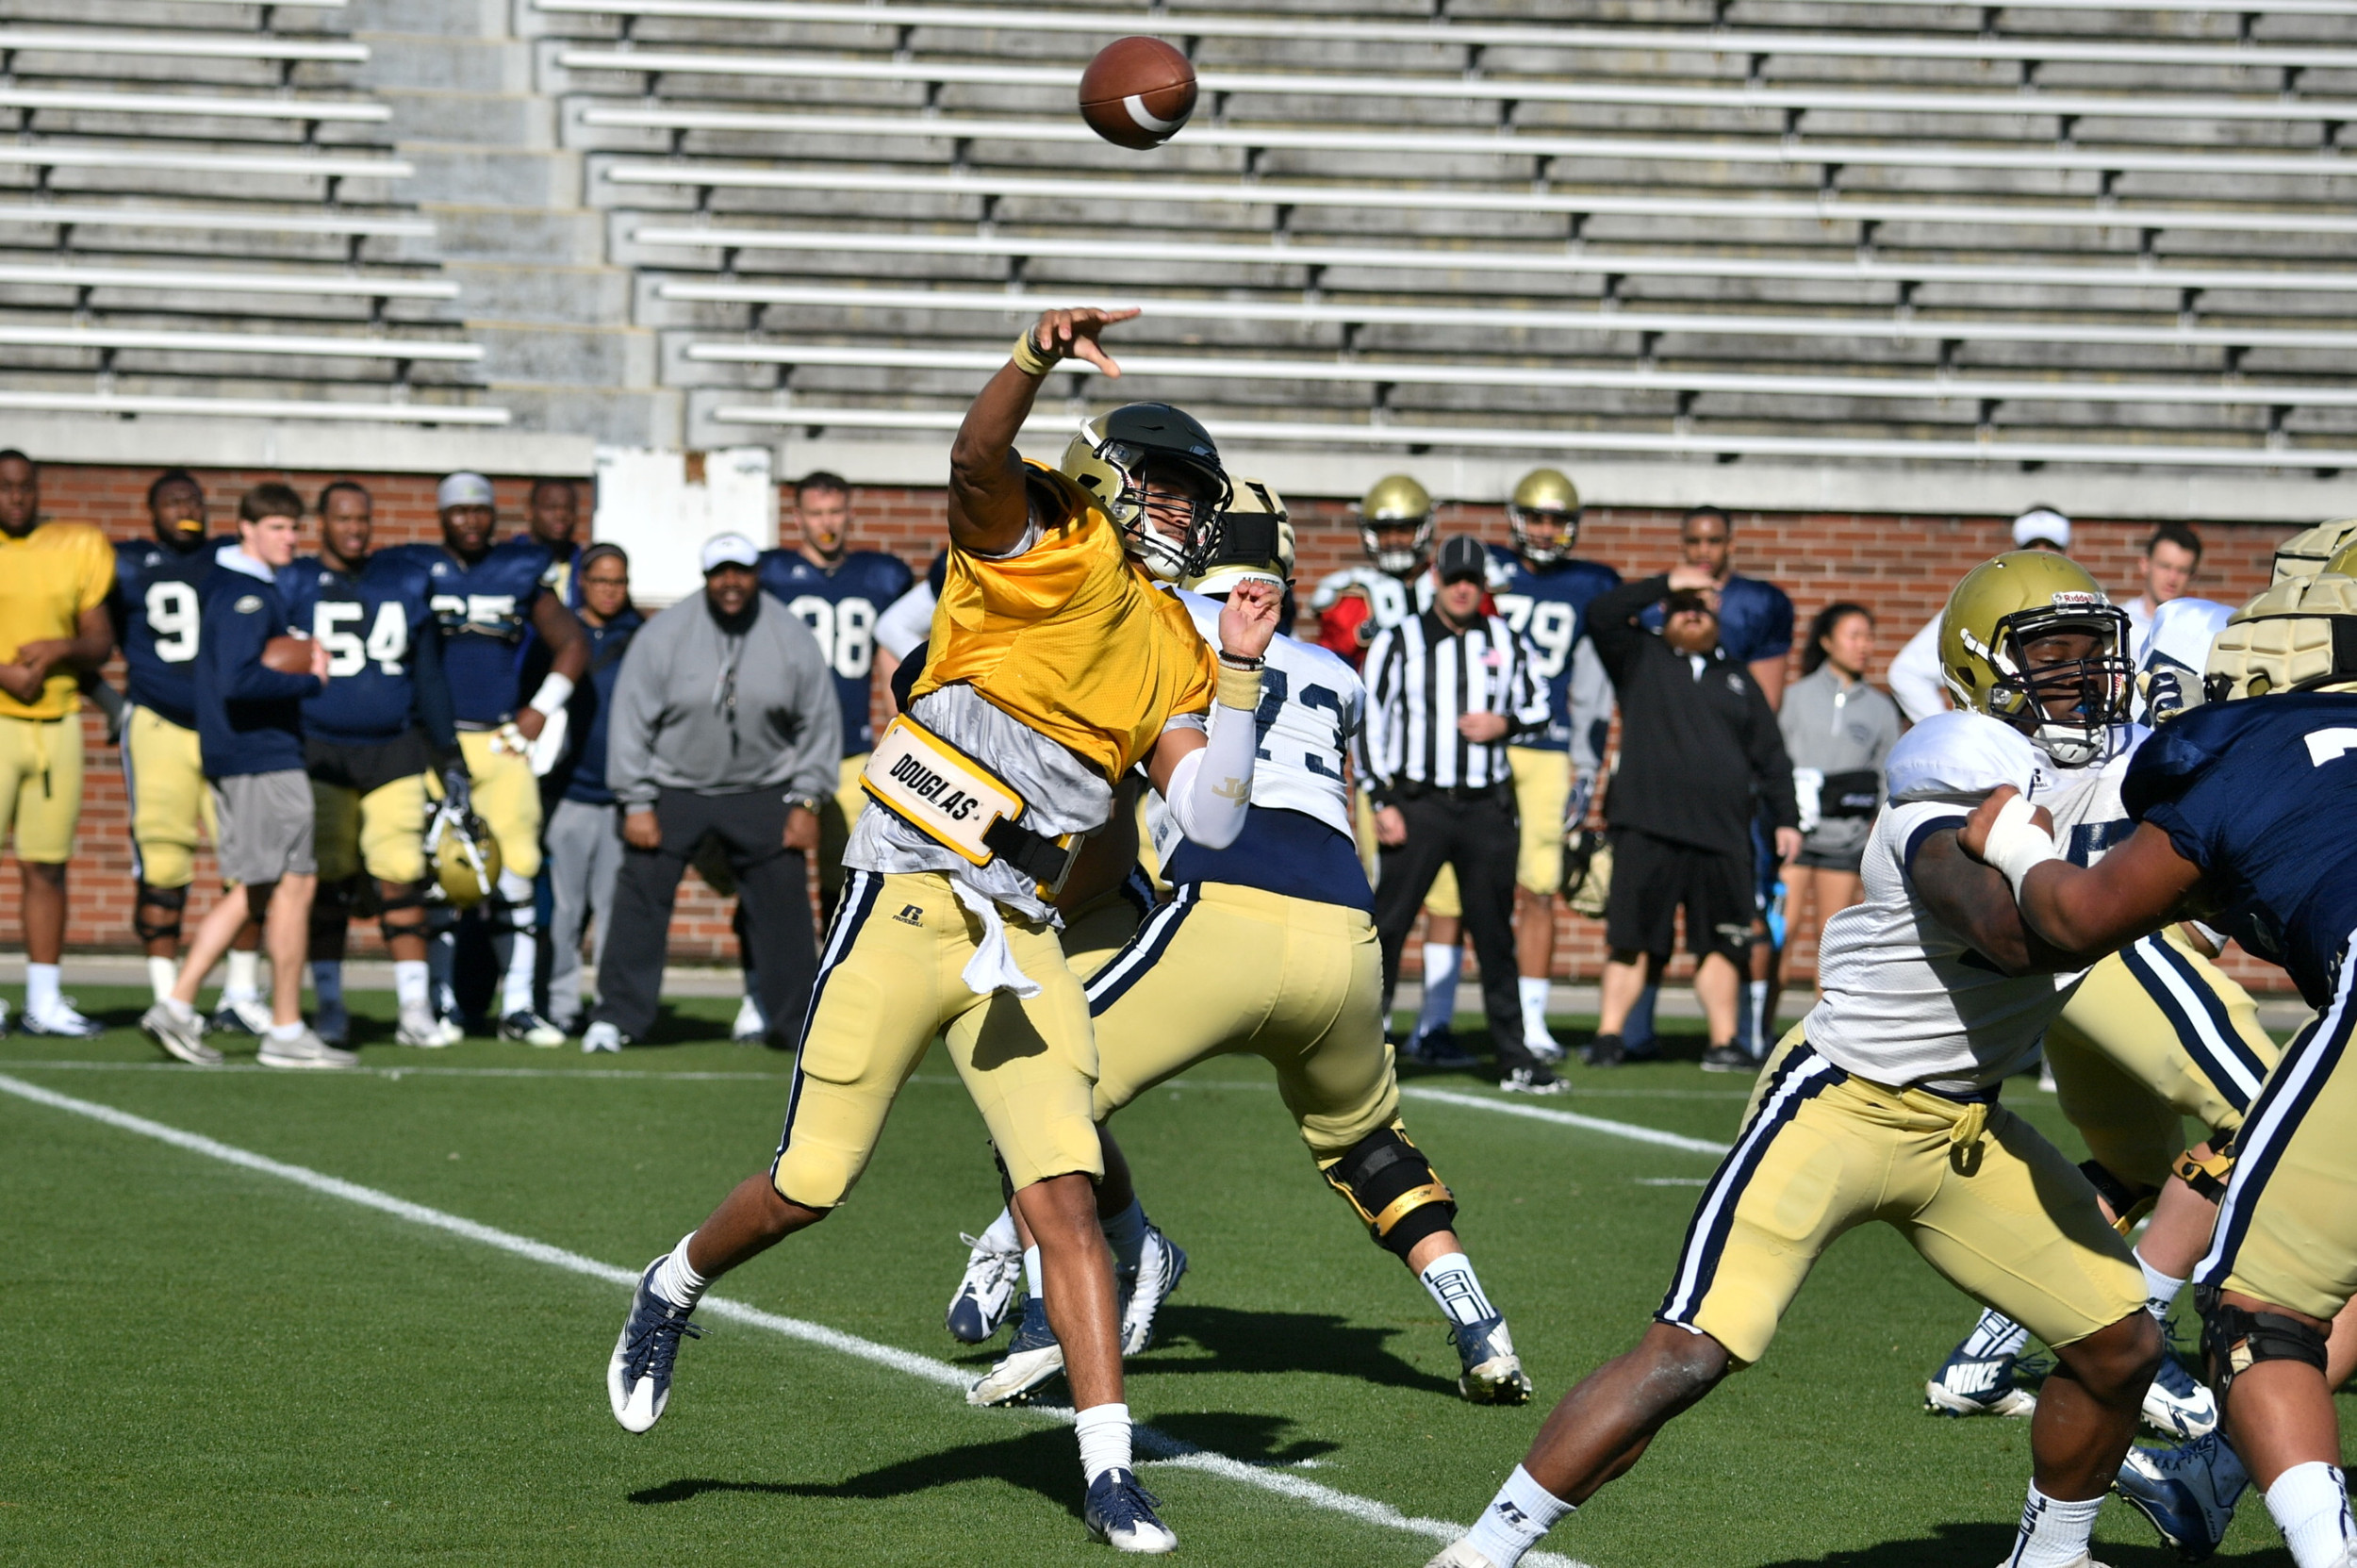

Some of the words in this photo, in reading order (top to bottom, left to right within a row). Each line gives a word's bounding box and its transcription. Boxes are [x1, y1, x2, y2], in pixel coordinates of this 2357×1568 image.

[144, 580, 201, 663] 9
[313, 601, 408, 677] 54
[1492, 593, 1576, 678] 79
[889, 752, 979, 821] DOUGLAS
[1943, 1361, 2003, 1395] NIKE
